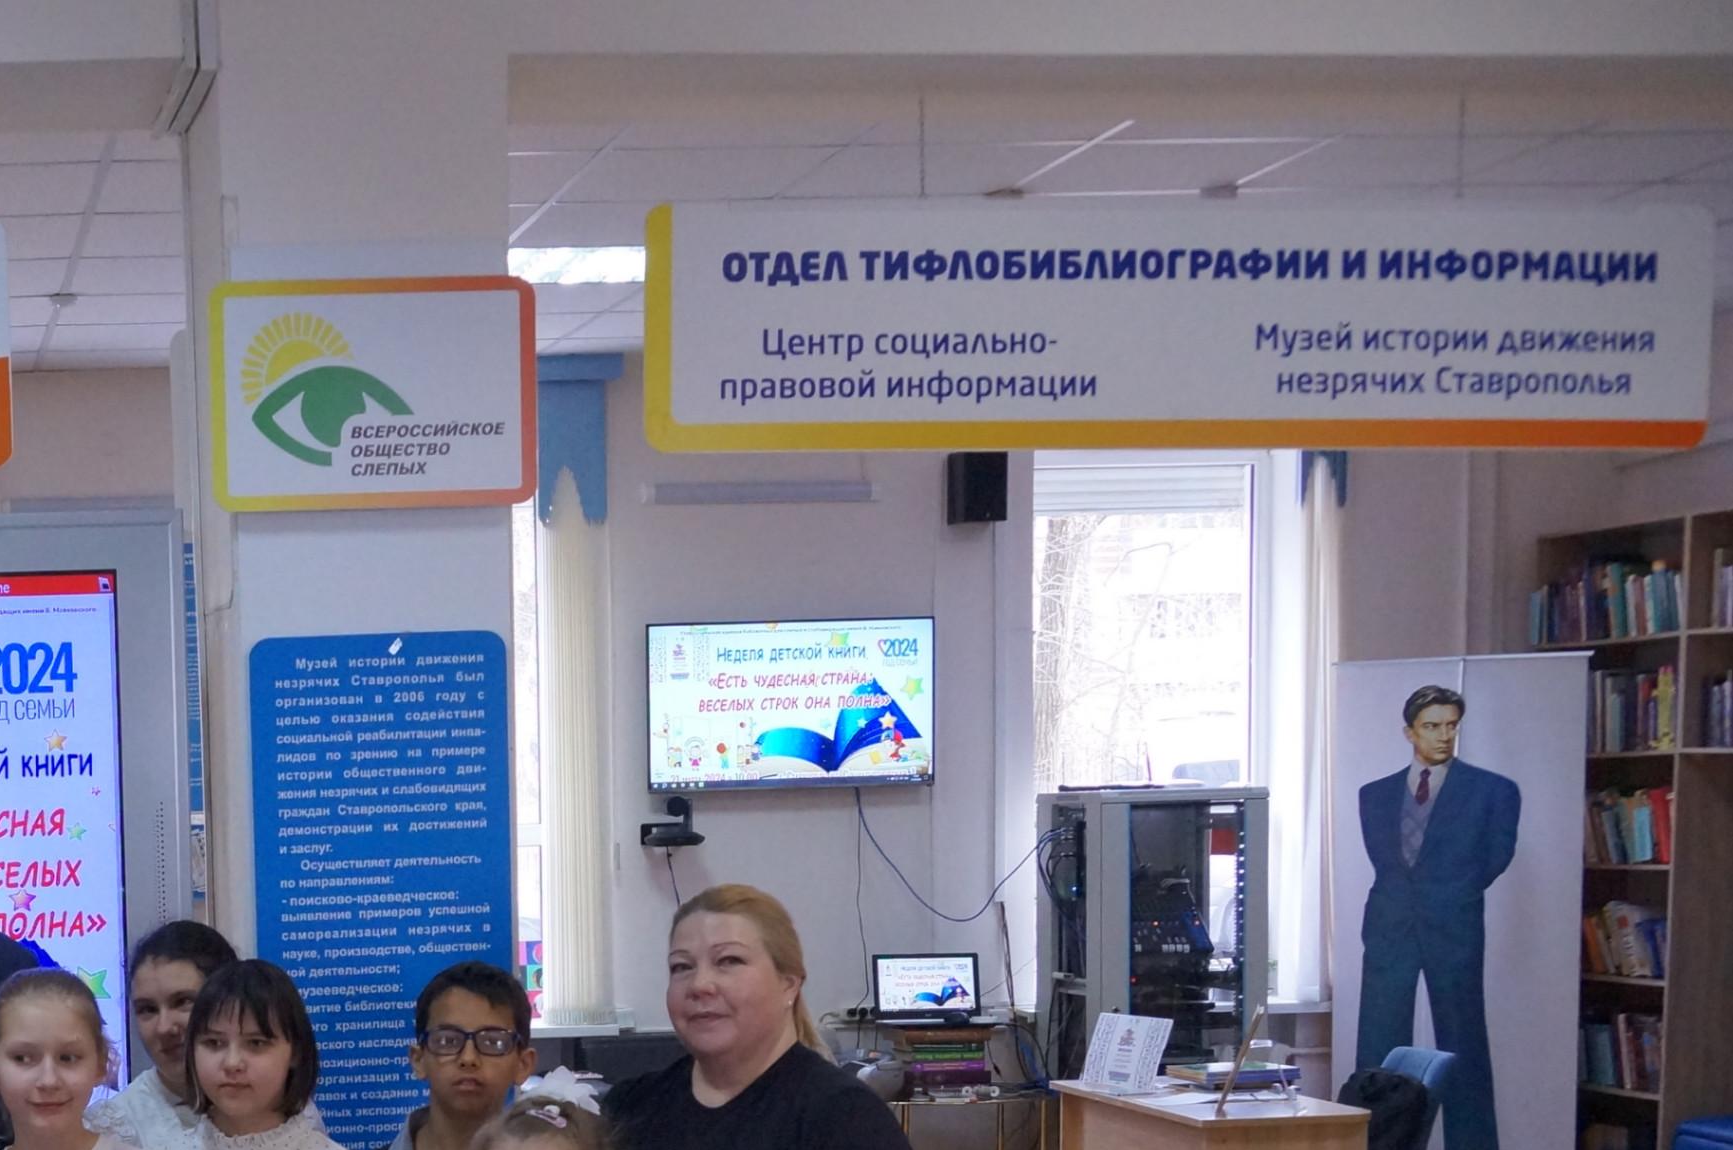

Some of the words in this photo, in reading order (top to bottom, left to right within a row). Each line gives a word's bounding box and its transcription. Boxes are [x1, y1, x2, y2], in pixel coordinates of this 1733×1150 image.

[722, 250, 848, 286] ОТДЕЛ
[860, 248, 1329, 281] ТИФЛОБИБЛИОГРАФИИ
[1343, 249, 1366, 279] И
[1379, 248, 1658, 286] ИНФОРМАЦИИ
[763, 328, 864, 361] Центр
[874, 330, 1058, 358] социально-
[1255, 322, 1352, 357] Музей
[1363, 326, 1488, 356] истории
[1496, 328, 1655, 355] движения
[720, 369, 875, 405] правовой
[886, 369, 1097, 404] информации
[1276, 369, 1425, 400] незрячих
[1435, 366, 1631, 400] Ставрополья
[350, 420, 505, 440] ВСЕРОССИЙСКОЕ
[350, 441, 451, 459] ОБЩЕСТВО
[351, 462, 426, 477] СЛЕПЫХ
[883, 638, 918, 656] 2024
[296, 657, 338, 671] Музей
[348, 656, 405, 669] истории
[416, 654, 484, 667] движения
[275, 678, 339, 690] незрячих
[351, 674, 444, 687] Ставрополья
[456, 672, 484, 683] был
[275, 695, 363, 709] организован
[375, 695, 382, 703] в
[394, 691, 425, 703] 2006
[436, 691, 466, 704] году
[478, 691, 484, 700] с
[699, 698, 755, 712] ВЕСЕЛЫХ
[761, 697, 798, 710] СТРОК
[805, 696, 830, 709] ОНА
[276, 715, 321, 727] целью
[331, 713, 394, 723] оказания
[405, 709, 485, 722] содействия
[276, 731, 353, 745] социальной
[357, 729, 447, 743] реабилитации
[277, 753, 316, 764] лидов
[326, 752, 341, 762] по
[350, 750, 398, 762] зрению
[407, 749, 422, 758] на
[431, 747, 486, 759] примере
[21, 753, 92, 777] КНИГИ
[277, 770, 332, 782] истории
[343, 765, 446, 780] общественного
[456, 764, 487, 775] дви-
[278, 789, 317, 799] жения
[320, 787, 378, 800] незрячих
[382, 786, 389, 795] и
[393, 782, 486, 796] слабовидящих
[279, 807, 330, 820] граждан
[337, 802, 447, 818] Ставропольского
[279, 824, 373, 837] демонстрации
[384, 823, 398, 832] их
[409, 818, 487, 831] достижений
[279, 846, 287, 854] и
[290, 843, 333, 855] заслуг.
[300, 857, 390, 872] Осуществляет
[394, 854, 481, 868] деятельность
[280, 879, 296, 889] по
[299, 875, 394, 888] направлениям:
[281, 910, 352, 922] выявление
[359, 907, 422, 920] примеров
[428, 903, 490, 917] успешной
[282, 927, 397, 941] самореализации
[408, 924, 472, 937] незрячих
[483, 924, 490, 932] в
[282, 949, 321, 962] науке,
[419, 941, 491, 954] обществен-
[309, 964, 401, 978] деятельности;
[335, 1019, 405, 1032] хранилища
[362, 1088, 419, 1100] создание
